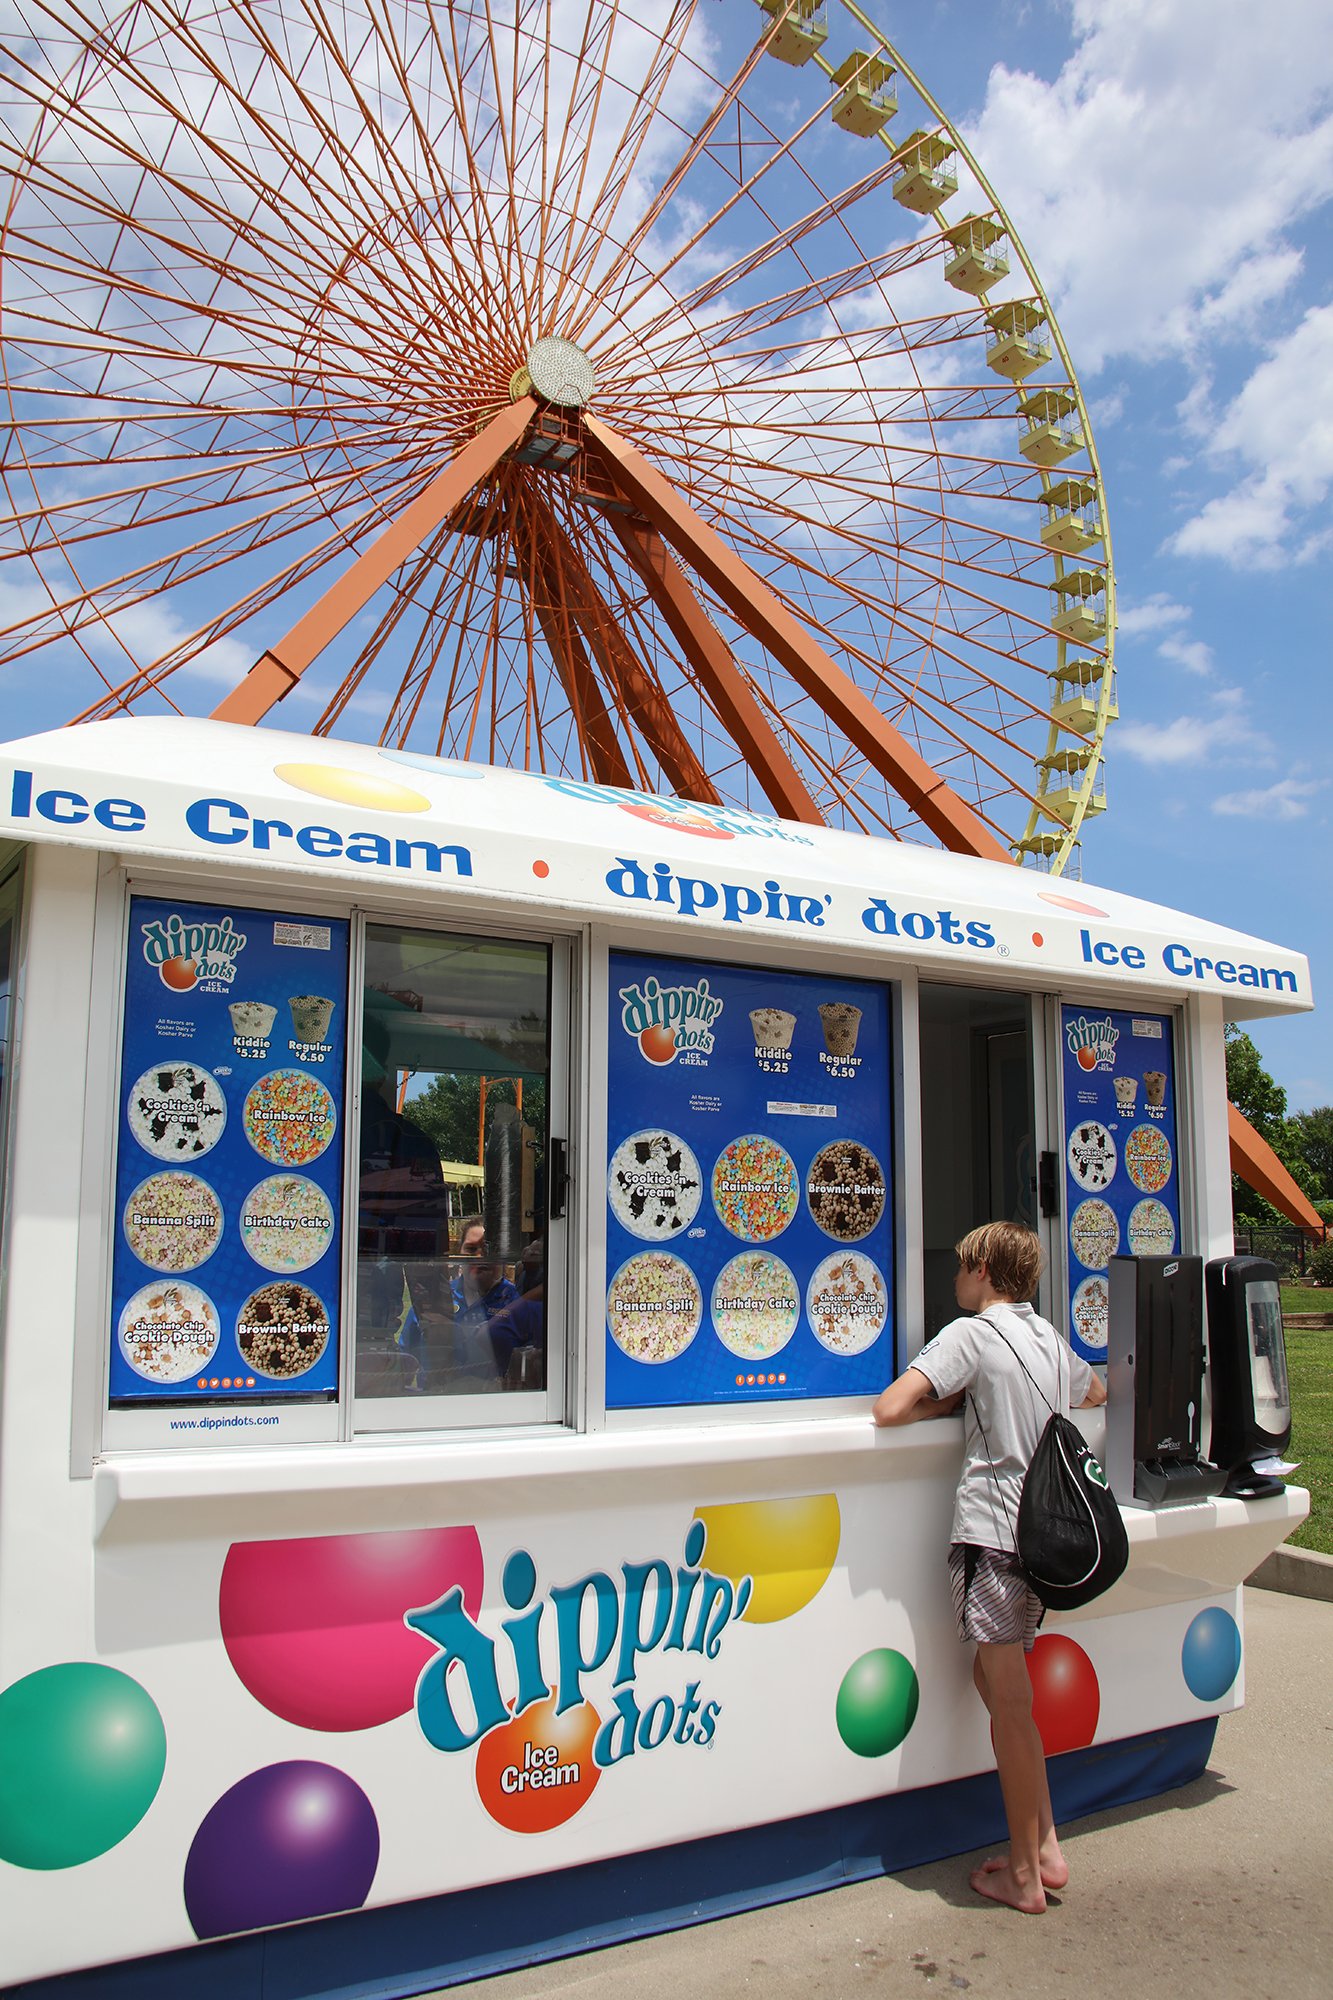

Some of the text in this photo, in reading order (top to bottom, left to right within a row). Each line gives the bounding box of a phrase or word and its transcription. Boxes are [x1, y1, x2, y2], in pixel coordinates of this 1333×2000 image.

[711, 816, 815, 847] dots
[11, 768, 1299, 993] Ice Cream dippin' dots Ice Cream
[142, 914, 246, 966] dippin'
[195, 956, 236, 980] dots
[200, 986, 230, 994] CREAM
[621, 978, 722, 1035] dippin'
[175, 1025, 189, 1033] Dairy
[1066, 1016, 1119, 1052] dippin'
[232, 1036, 272, 1049] Kiddie
[674, 1024, 712, 1050] dots
[236, 1047, 267, 1059] $5.25
[288, 1040, 333, 1053] Regular
[754, 1046, 793, 1061] Kiddie
[294, 1051, 325, 1063] $6.50
[686, 1052, 701, 1060] ICE
[818, 1051, 862, 1067] Regular
[1095, 1046, 1115, 1062] dots
[679, 1058, 709, 1067] CREAM
[758, 1059, 789, 1074] $5.25
[825, 1064, 856, 1079] $6.50
[145, 1098, 195, 1112] Cookies
[1116, 1102, 1136, 1110] Kiddie
[1144, 1103, 1167, 1113] Regular
[157, 1111, 198, 1124] Cream
[253, 1109, 327, 1123] Rainbow Ice
[1118, 1110, 1134, 1118] $5.25
[1148, 1111, 1164, 1119] $6.50
[1075, 1148, 1100, 1157] Cookies
[1129, 1152, 1168, 1162] Rainbow Ice
[1082, 1156, 1104, 1165] Cream
[624, 1171, 673, 1185] Cookies
[636, 1185, 676, 1199] Cream
[722, 1180, 789, 1194] Rainbow Ice
[808, 1183, 886, 1196] Brownie Batter
[132, 1214, 215, 1229] Banana Split
[244, 1215, 331, 1230] Birthday Cake
[1074, 1229, 1116, 1239] Banana Split
[1129, 1228, 1174, 1239] Birthday Cake
[715, 1298, 797, 1312] Birthday Cake
[819, 1292, 875, 1304] Chocolate Chip
[615, 1299, 694, 1315] Banana Split
[811, 1302, 884, 1316] Cookie Dough
[1079, 1304, 1103, 1312] Chocolate
[1074, 1311, 1098, 1321] Cookie
[134, 1320, 205, 1333] Chocolate Chip
[238, 1323, 330, 1335] Brownie Batter
[124, 1331, 215, 1345] Cookie Dough
[170, 1415, 280, 1431] www.dippindots.com
[405, 1517, 752, 1754] dippin'
[595, 1679, 723, 1768] dots
[523, 1741, 558, 1770] Ice
[500, 1761, 580, 1795] Cream
